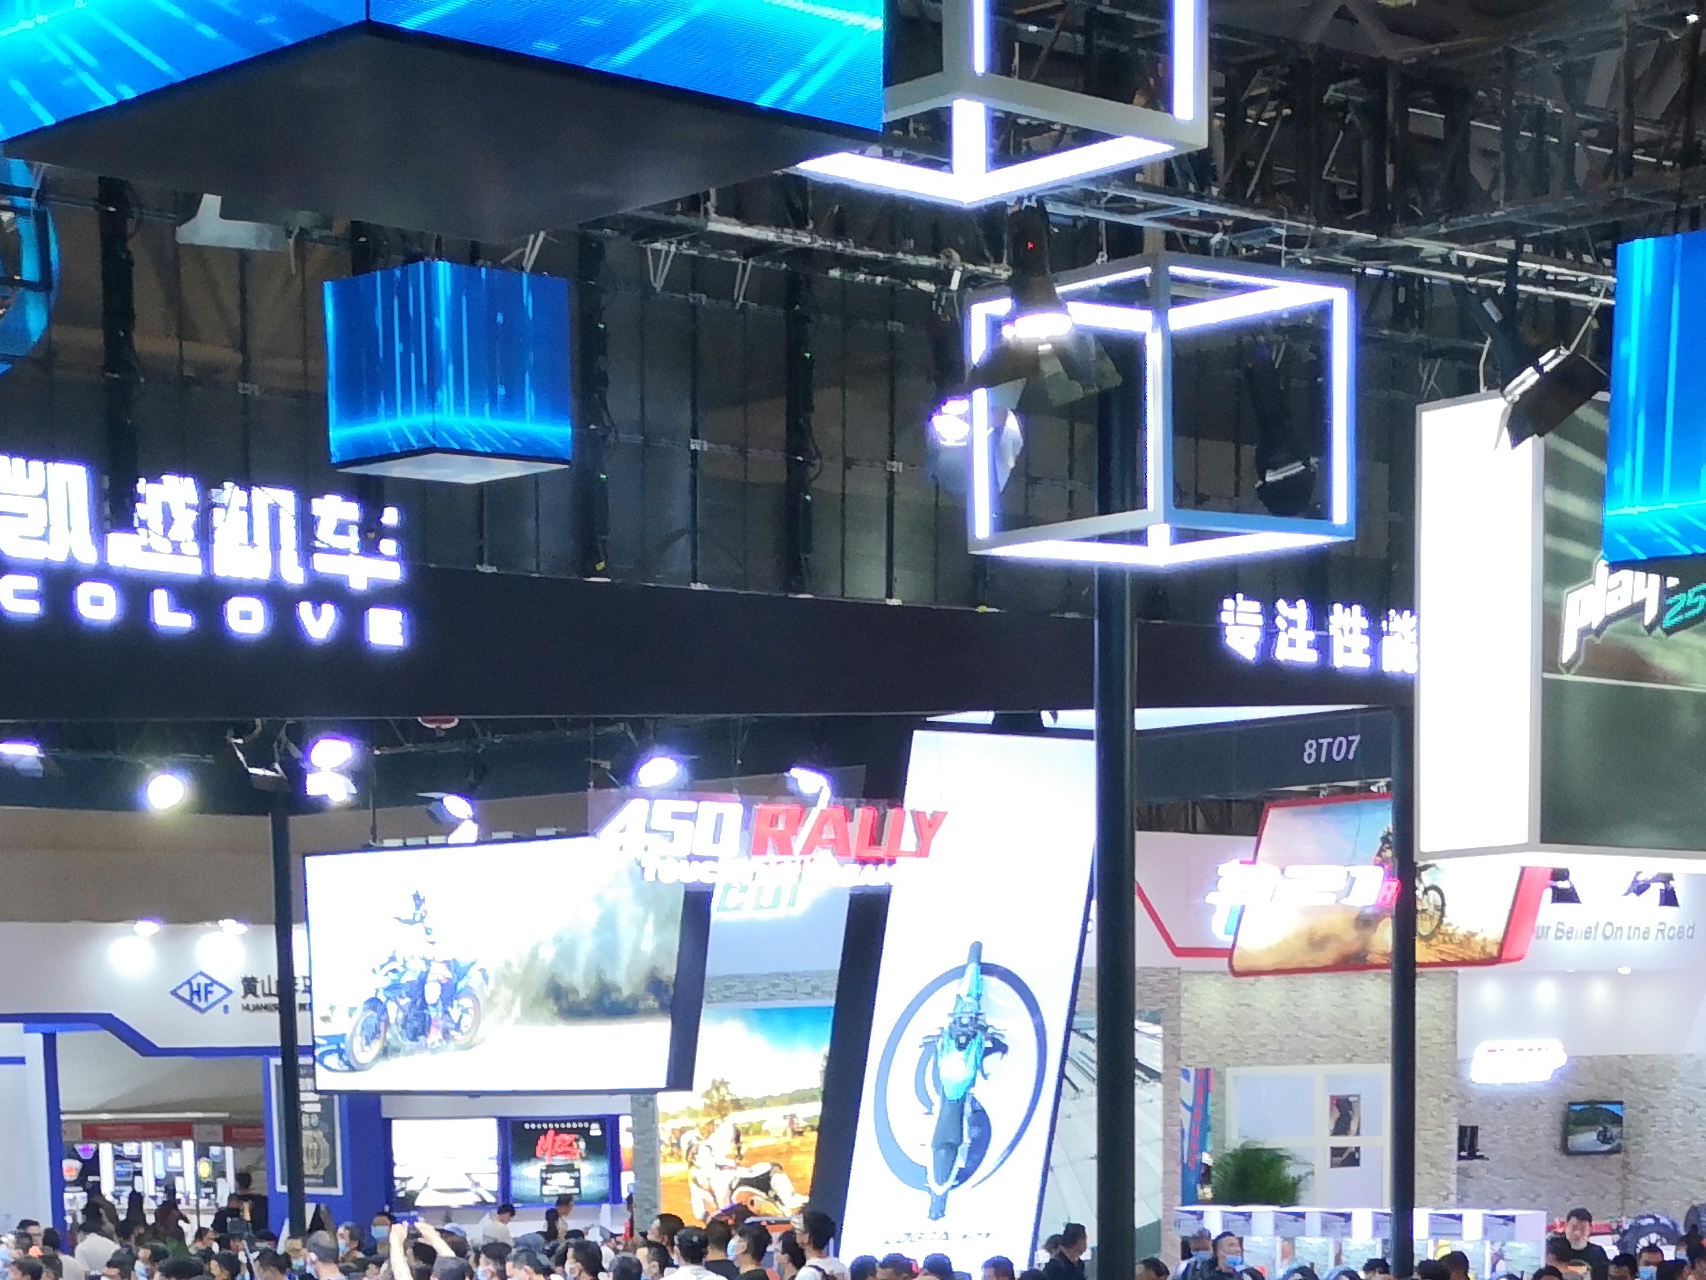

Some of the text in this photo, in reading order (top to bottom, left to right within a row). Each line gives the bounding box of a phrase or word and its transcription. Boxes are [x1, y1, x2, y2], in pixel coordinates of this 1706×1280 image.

[1303, 734, 1361, 764] 8T07
[751, 803, 948, 861] RALLY
[1602, 922, 1623, 940] On
[1655, 922, 1695, 940] Road
